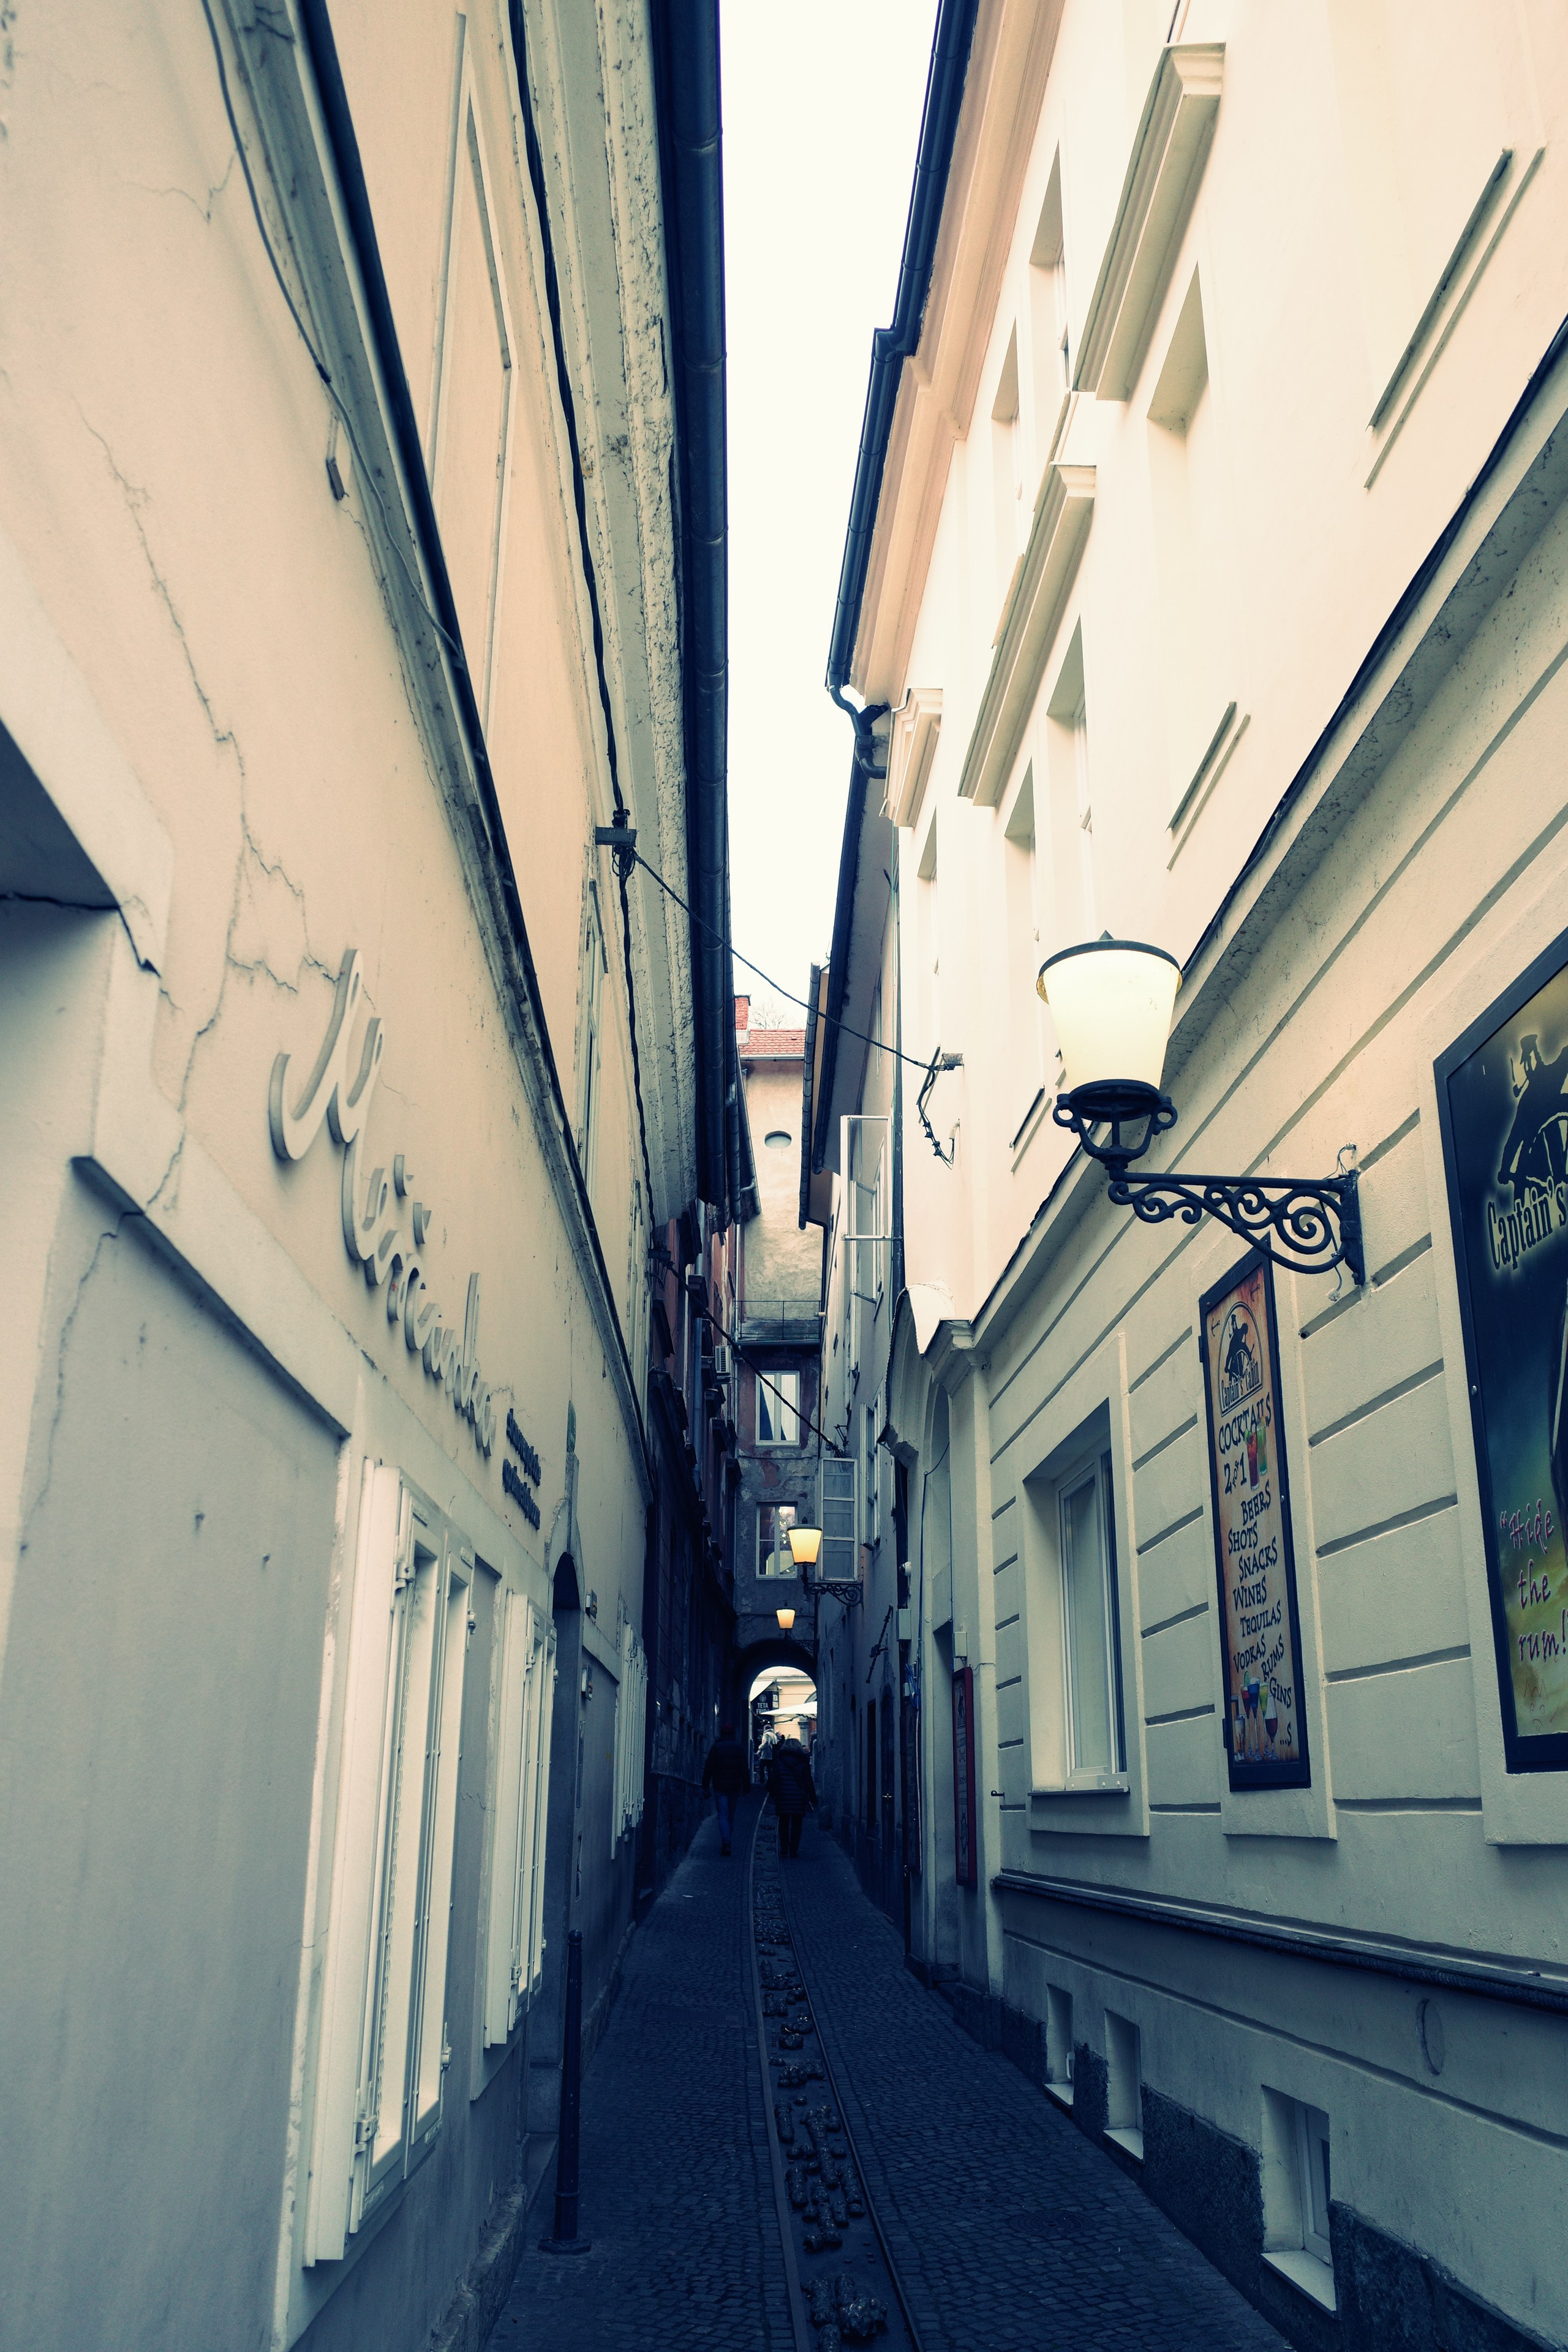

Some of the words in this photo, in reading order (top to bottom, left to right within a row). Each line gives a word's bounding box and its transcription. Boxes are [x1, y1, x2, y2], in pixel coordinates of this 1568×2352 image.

[1488, 1179, 1566, 1270] Captain's
[1221, 1375, 1243, 1410] Captain's
[1245, 1358, 1261, 1392] Cabin
[1219, 1392, 1272, 1455] COCKTAILS
[1224, 1463, 1232, 1494] 2
[1240, 1452, 1247, 1486] 1
[1241, 1479, 1271, 1526] BEERS
[1228, 1520, 1258, 1556] SHOTS
[1238, 1536, 1278, 1583] SNACKS
[1233, 1575, 1267, 1611] WINES
[1518, 1559, 1551, 1610] the
[1240, 1599, 1281, 1637] TEQUILAS
[1233, 1632, 1266, 1673] VODKAS
[1261, 1632, 1284, 1682] RUMS
[1269, 1676, 1292, 1709] GINS
